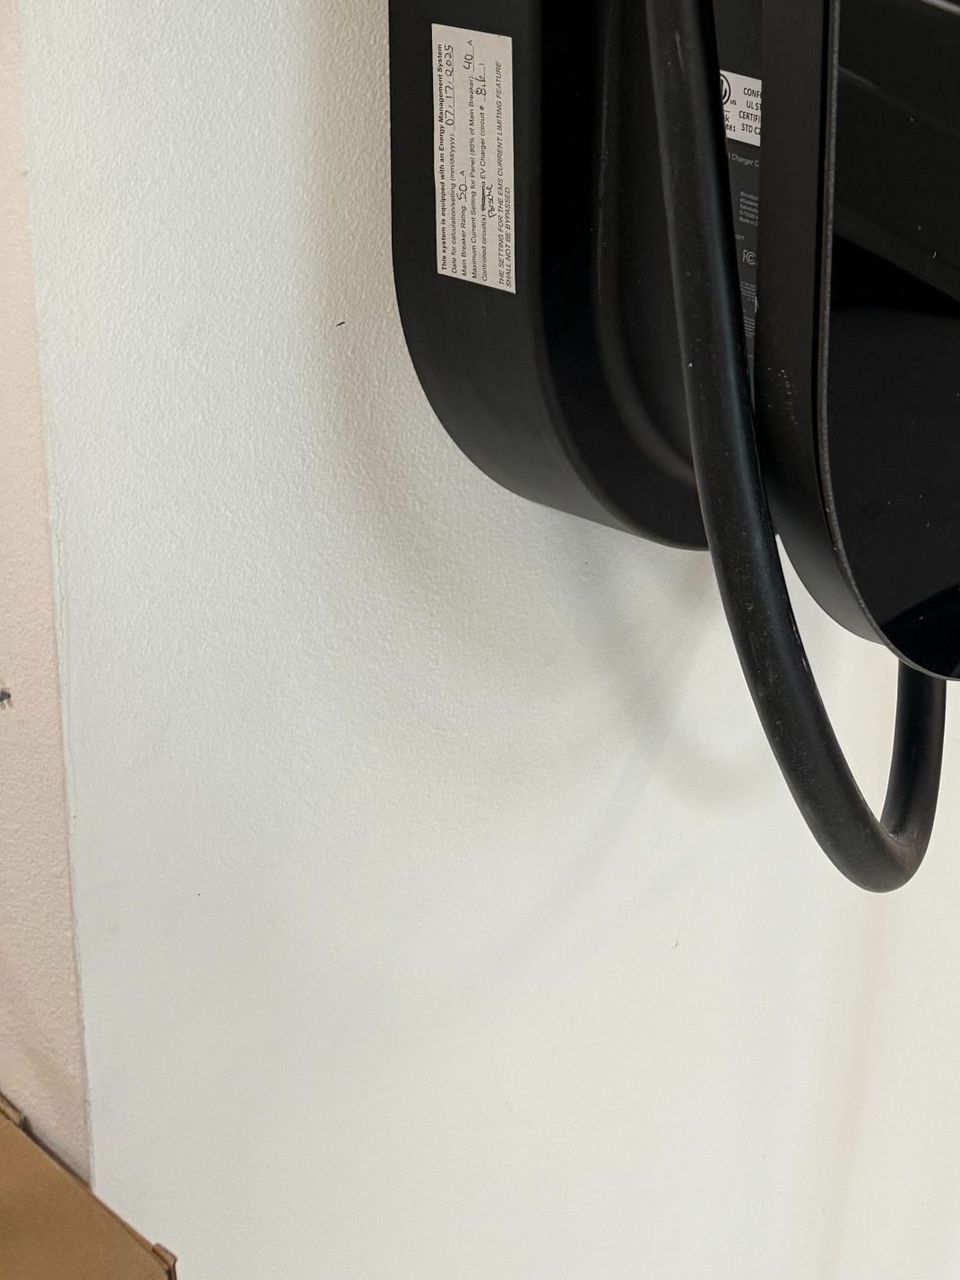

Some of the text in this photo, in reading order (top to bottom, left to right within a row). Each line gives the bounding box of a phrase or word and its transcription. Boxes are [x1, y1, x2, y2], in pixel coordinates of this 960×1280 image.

[462, 54, 473, 70] 40
[743, 87, 761, 98] CONF
[746, 100, 754, 110] UL
[741, 123, 753, 133] STD
[438, 125, 446, 151] Energy
[480, 168, 486, 179] EV
[439, 182, 447, 216] equipped
[456, 184, 468, 200] 50
[470, 191, 478, 215] Setting
[486, 184, 498, 218] Porsche
[440, 227, 448, 253] system
[505, 231, 511, 242] BE
